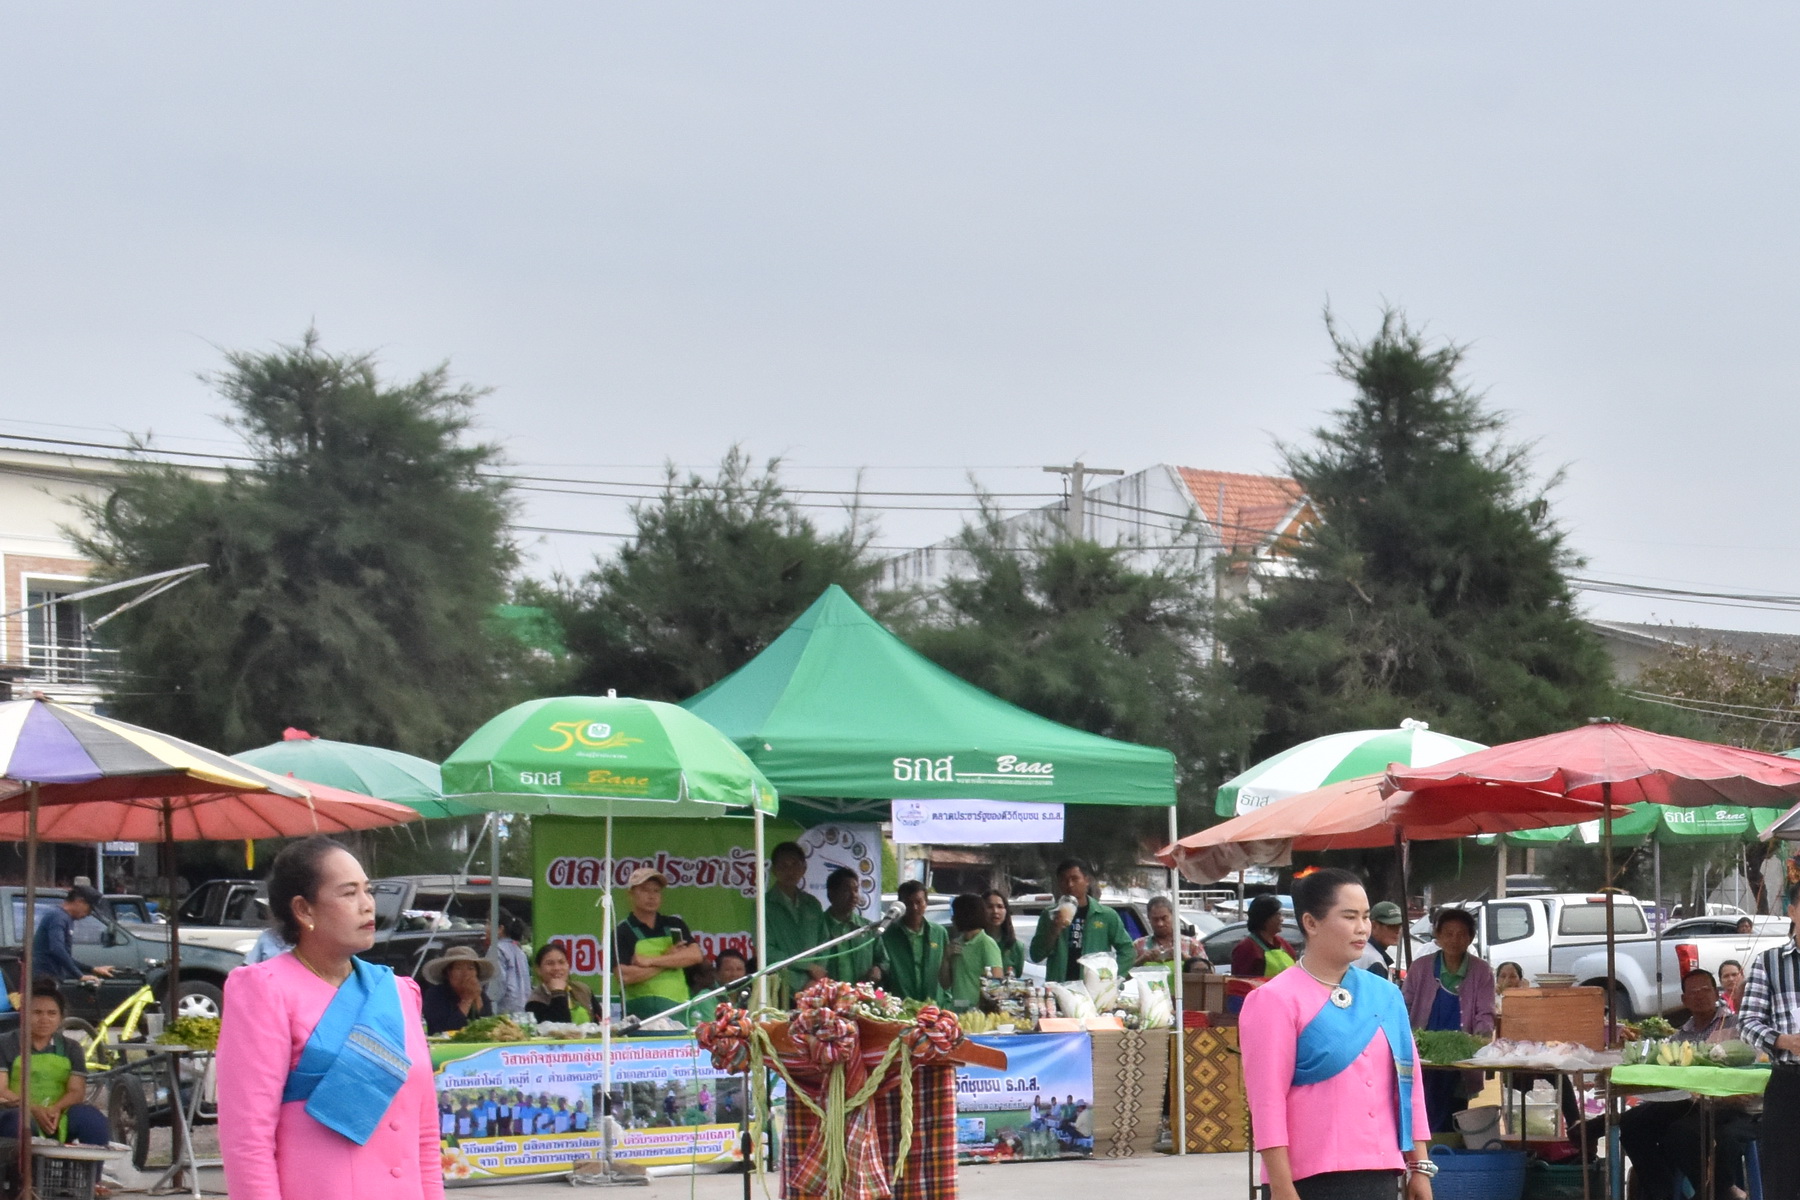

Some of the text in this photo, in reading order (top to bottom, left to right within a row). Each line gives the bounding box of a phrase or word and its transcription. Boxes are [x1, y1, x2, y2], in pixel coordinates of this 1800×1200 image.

[892, 754, 1055, 782] ธกส Baac
[519, 770, 562, 786] ธกส
[587, 769, 649, 785] Baac
[1665, 810, 1695, 823] ธกส
[1006, 1077, 1040, 1091] ธ.ก.ส.
